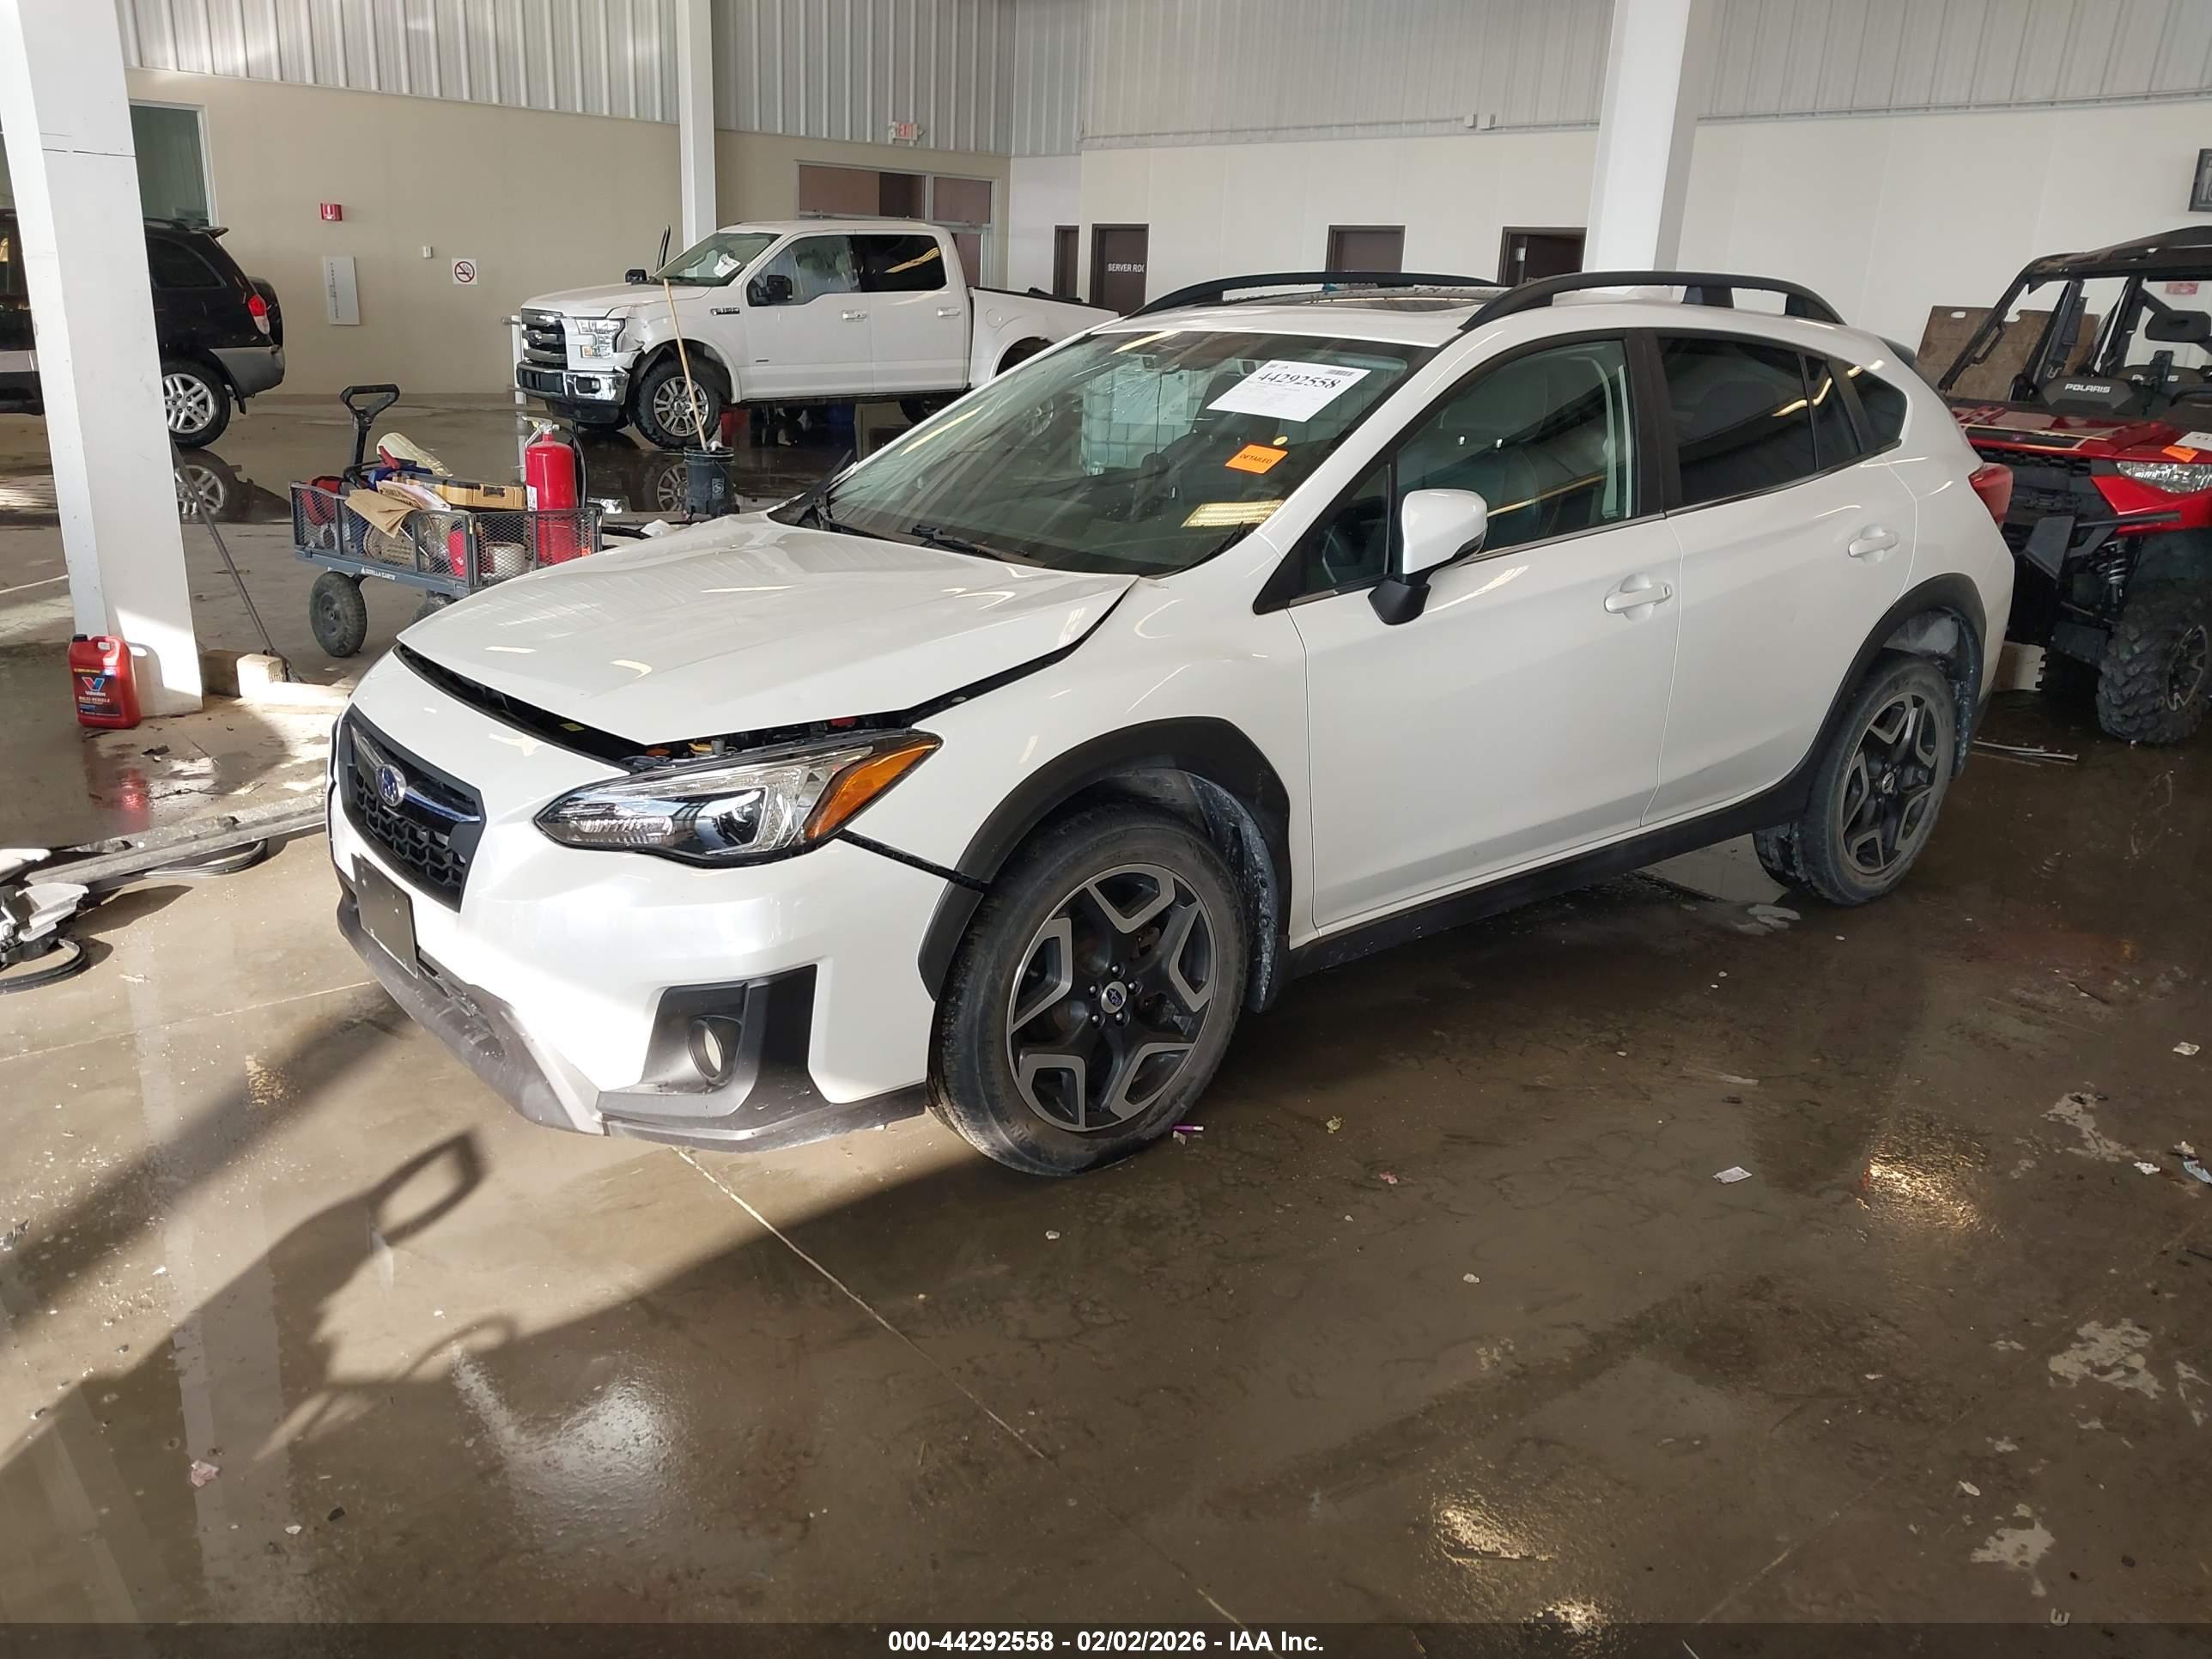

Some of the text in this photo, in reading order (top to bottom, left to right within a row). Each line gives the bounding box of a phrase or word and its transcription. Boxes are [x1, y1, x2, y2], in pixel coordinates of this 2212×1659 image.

[1108, 263, 1132, 272] SERVER
[1258, 372, 1341, 389] 44292558
[2065, 383, 2112, 393] POLARIS
[1239, 454, 1273, 465] DETAILED
